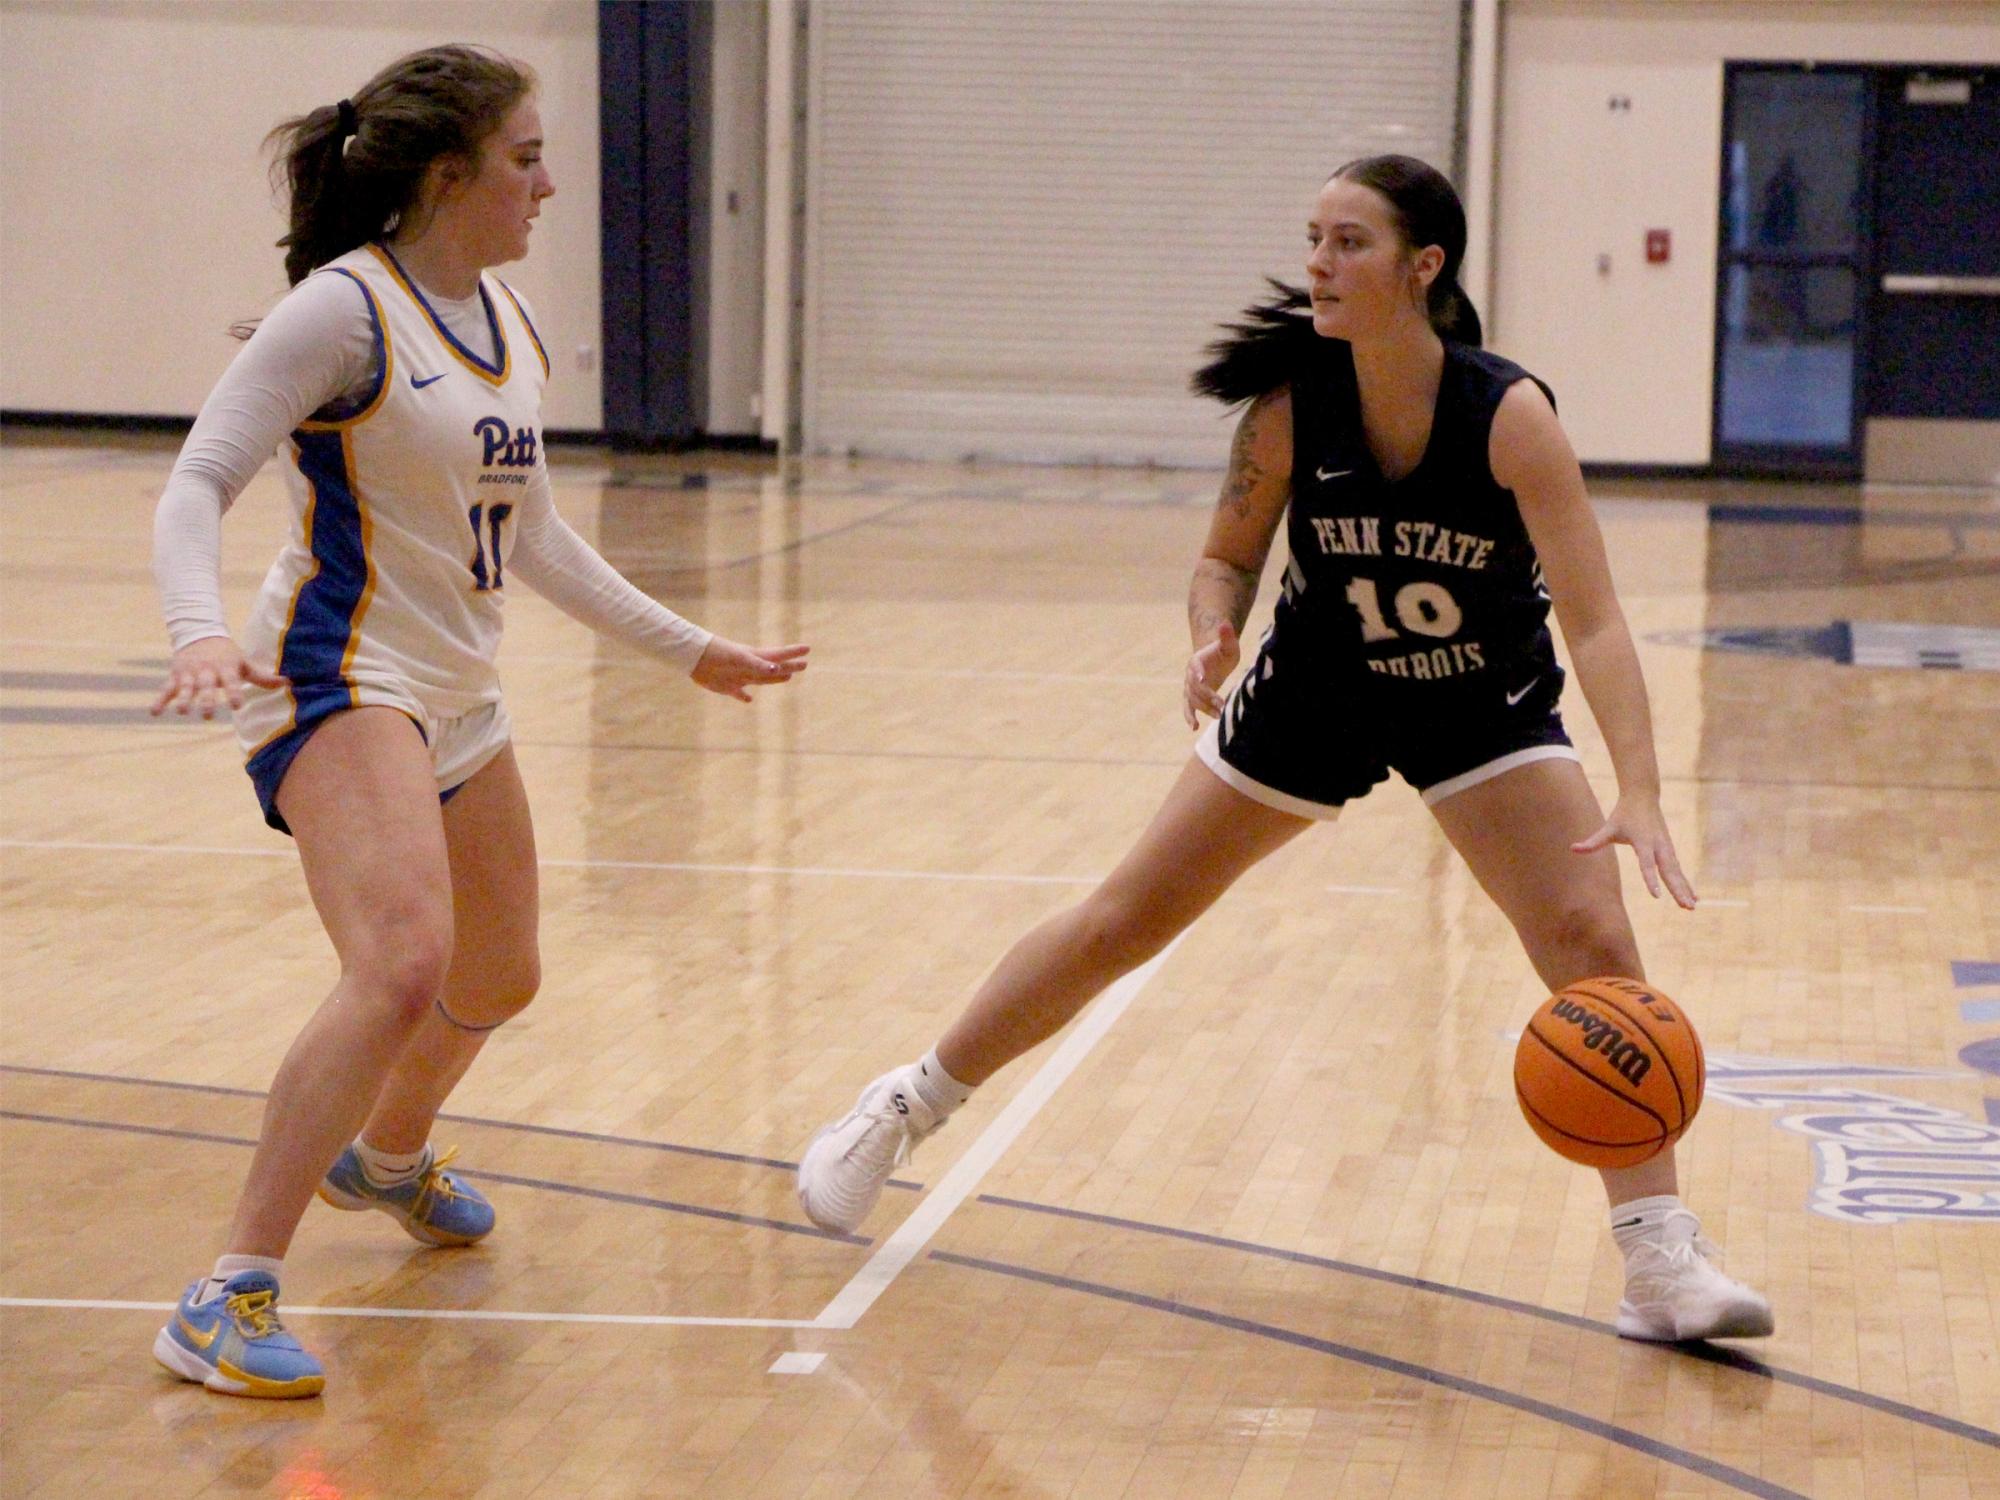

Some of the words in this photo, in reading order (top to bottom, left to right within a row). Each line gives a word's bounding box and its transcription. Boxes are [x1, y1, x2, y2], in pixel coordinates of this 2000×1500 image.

[473, 415, 537, 467] Pitt
[1310, 516, 1382, 555] PENN
[1394, 521, 1495, 570] STATE
[1345, 576, 1463, 643] 10
[1551, 999, 1652, 1088] Wilson
